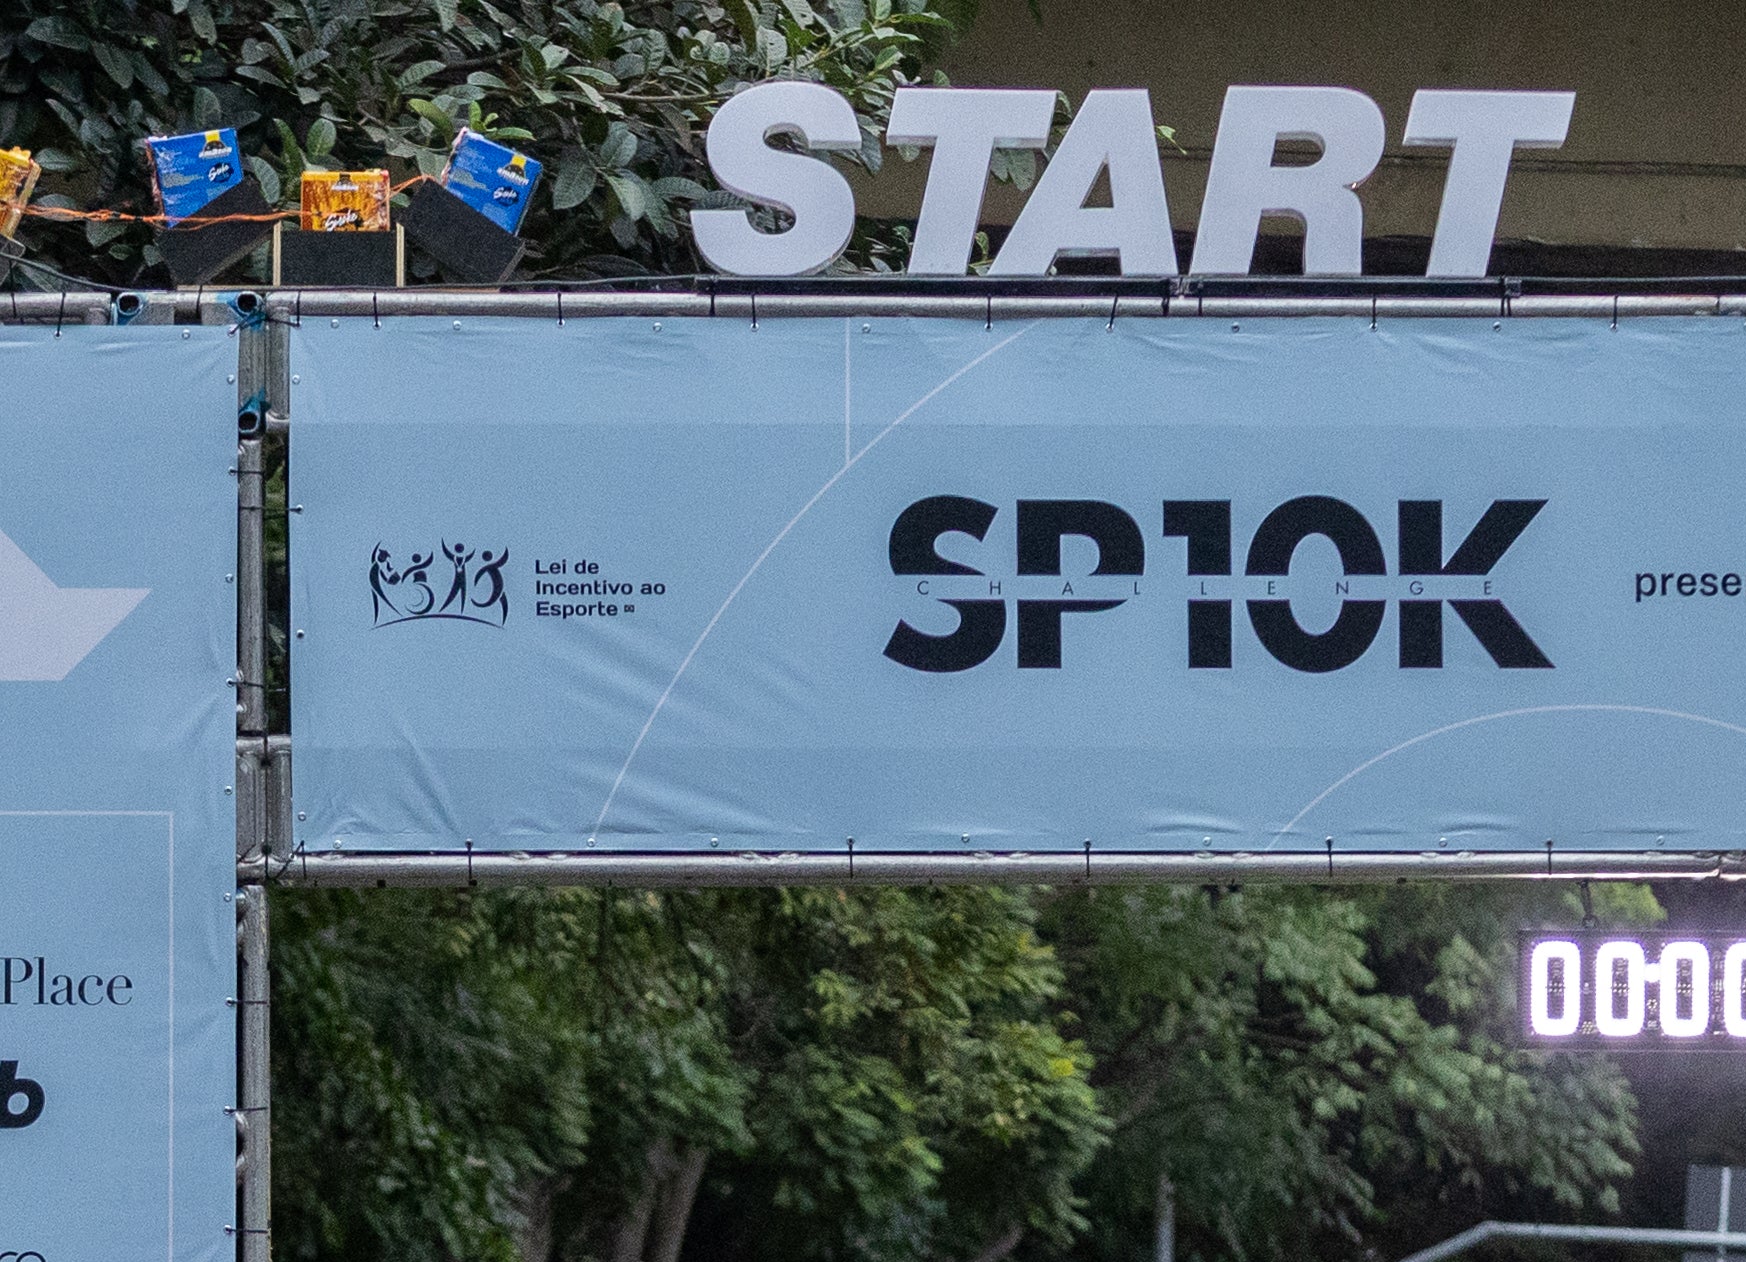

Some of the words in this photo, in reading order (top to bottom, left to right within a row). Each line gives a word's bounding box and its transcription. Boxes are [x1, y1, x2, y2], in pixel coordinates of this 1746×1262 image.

[691, 80, 1576, 277] START
[535, 559, 567, 575] Lei
[574, 559, 600, 575] de
[536, 580, 634, 596] Incentivo
[640, 583, 667, 596] ao
[884, 495, 1556, 674] SP10K
[917, 581, 1494, 597] CHALLENGE
[536, 601, 619, 620] Esporte
[0, 956, 134, 1006] Place
